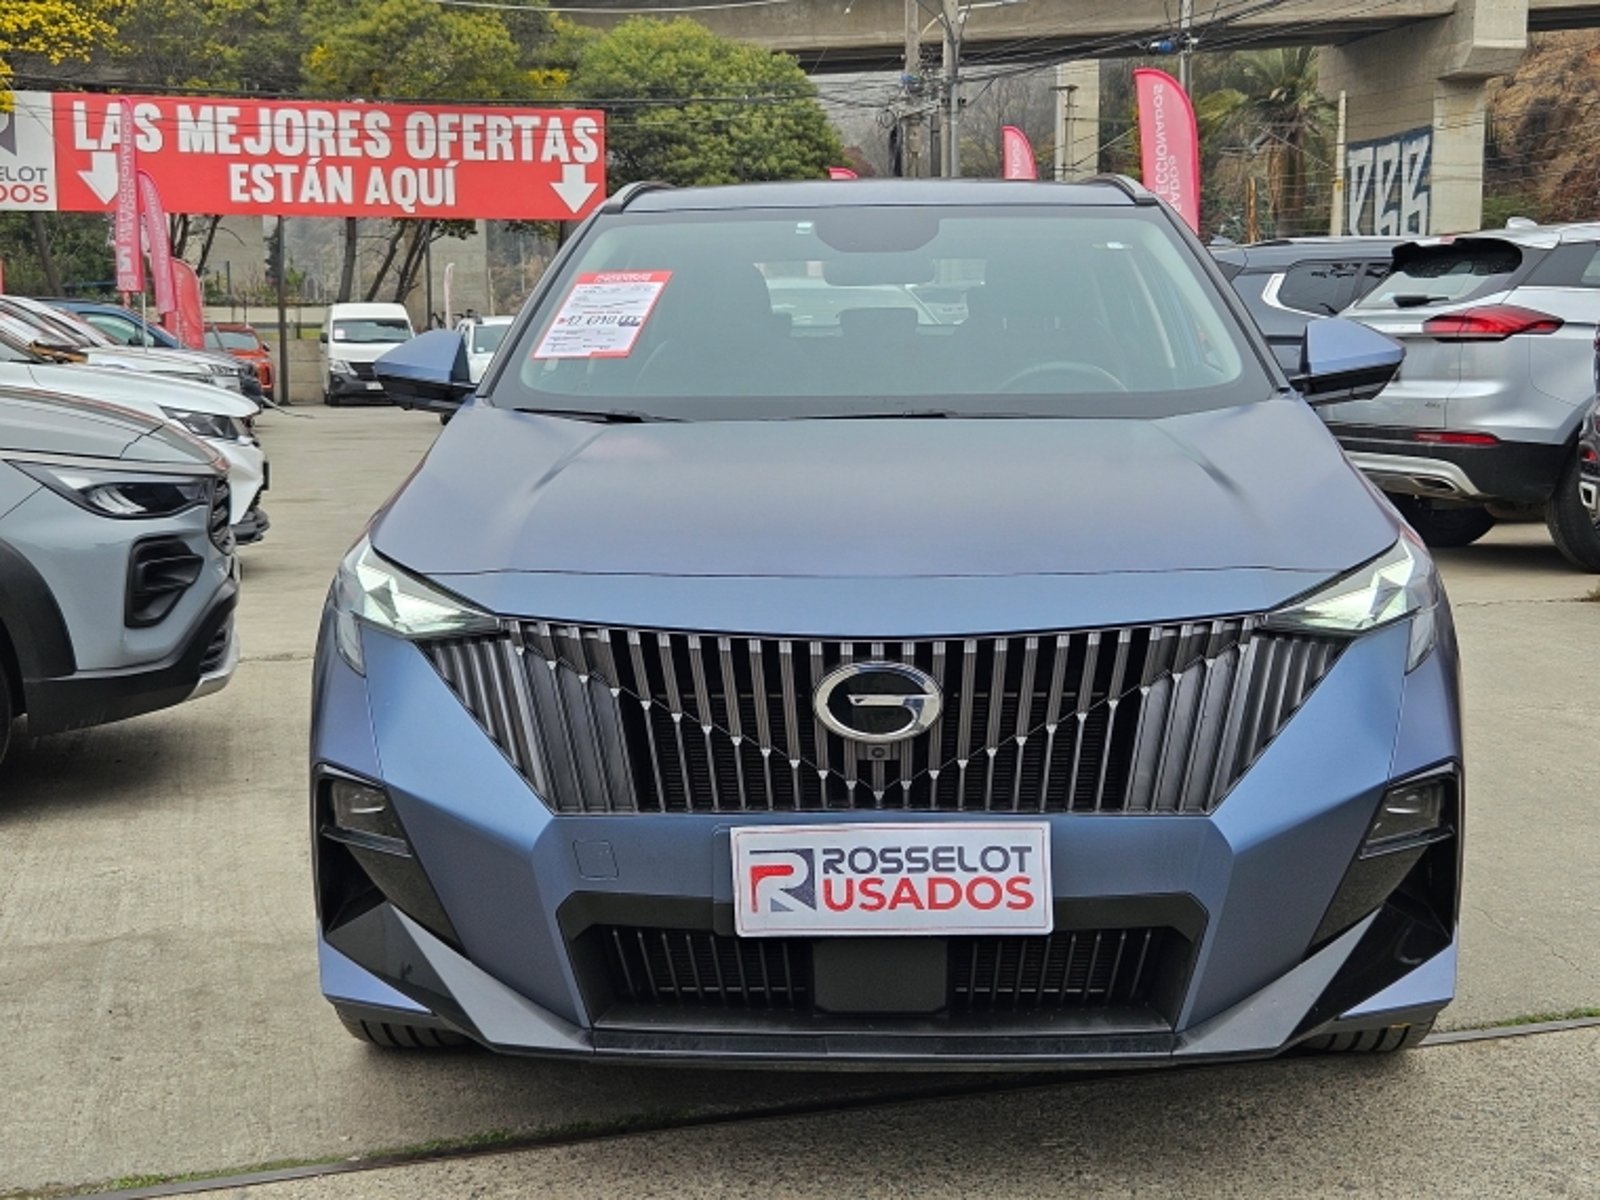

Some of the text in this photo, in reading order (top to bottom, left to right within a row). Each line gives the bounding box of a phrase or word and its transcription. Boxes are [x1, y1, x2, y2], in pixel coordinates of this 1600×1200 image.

[73, 100, 600, 164] LAS MEJORES OFERTAS
[229, 157, 460, 214] ESTÁN AQUÍ
[822, 846, 1032, 875] ROSSELOT
[822, 876, 1035, 913] USADOS
